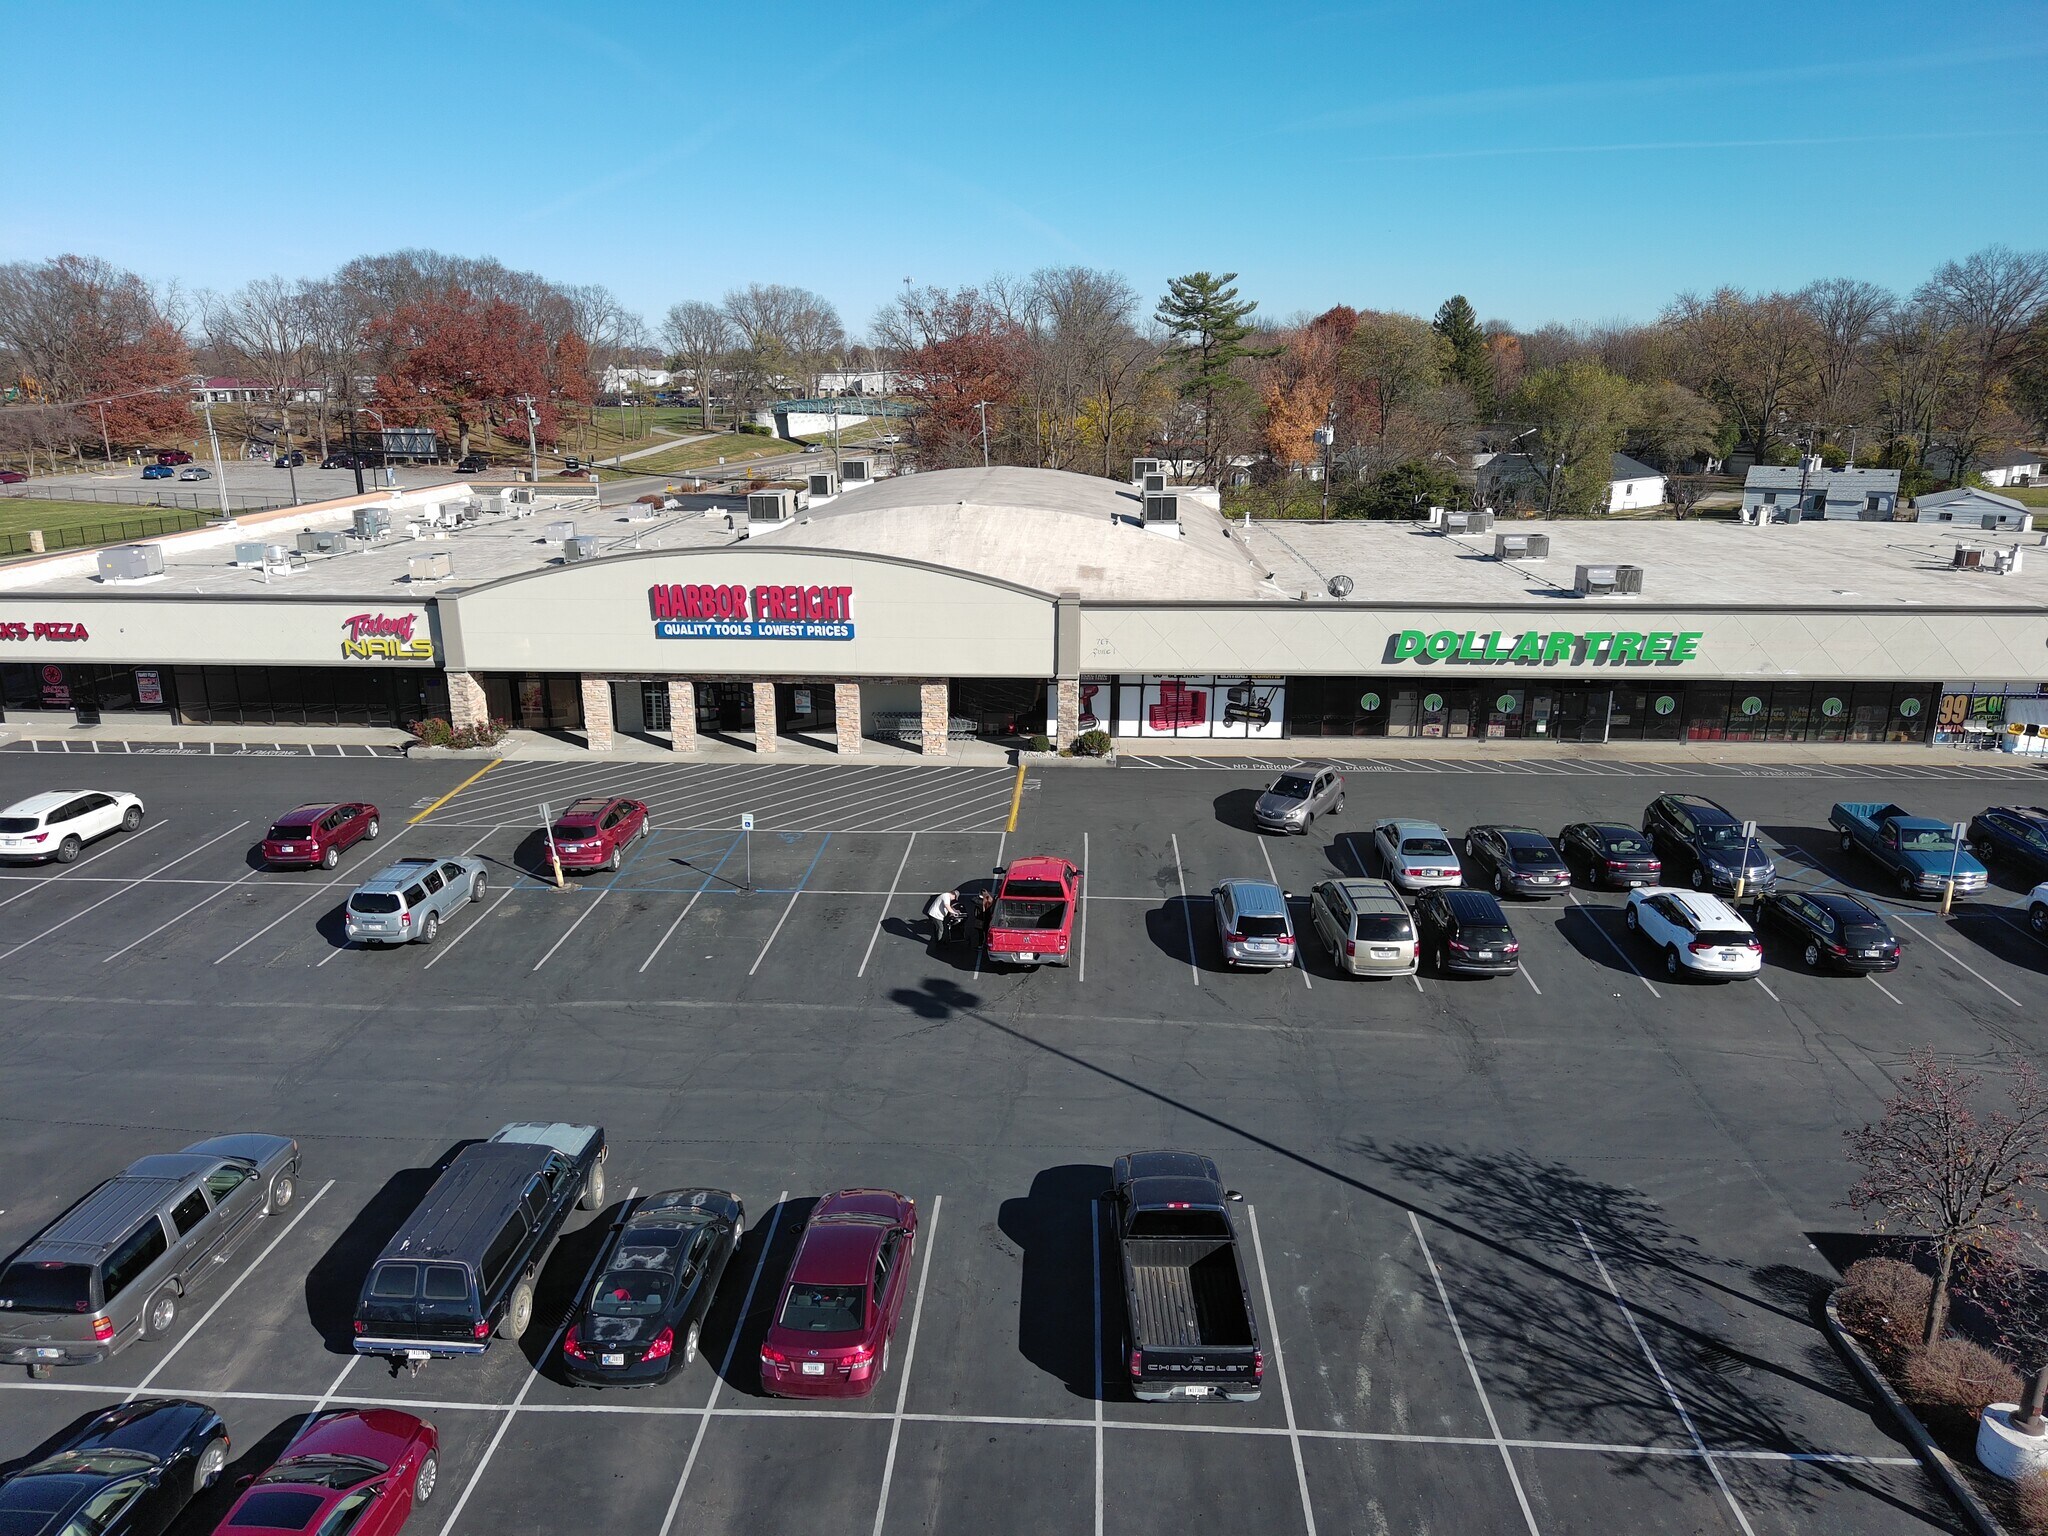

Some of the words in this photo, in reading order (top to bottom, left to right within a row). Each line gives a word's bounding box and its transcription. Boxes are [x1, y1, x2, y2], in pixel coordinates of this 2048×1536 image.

[653, 584, 748, 618] HARBOR
[755, 585, 852, 620] FREIGHT
[0, 622, 29, 641] K'S
[33, 622, 89, 641] PIZZA
[664, 624, 712, 635] QUALITY
[715, 624, 752, 636] TOOLS
[758, 624, 804, 636] LOWEST
[806, 626, 849, 637] PRICES
[344, 639, 433, 657] NAILS
[1394, 629, 1576, 660] DOLLAR
[1582, 630, 1704, 660] TREE
[1940, 695, 1968, 724] 99
